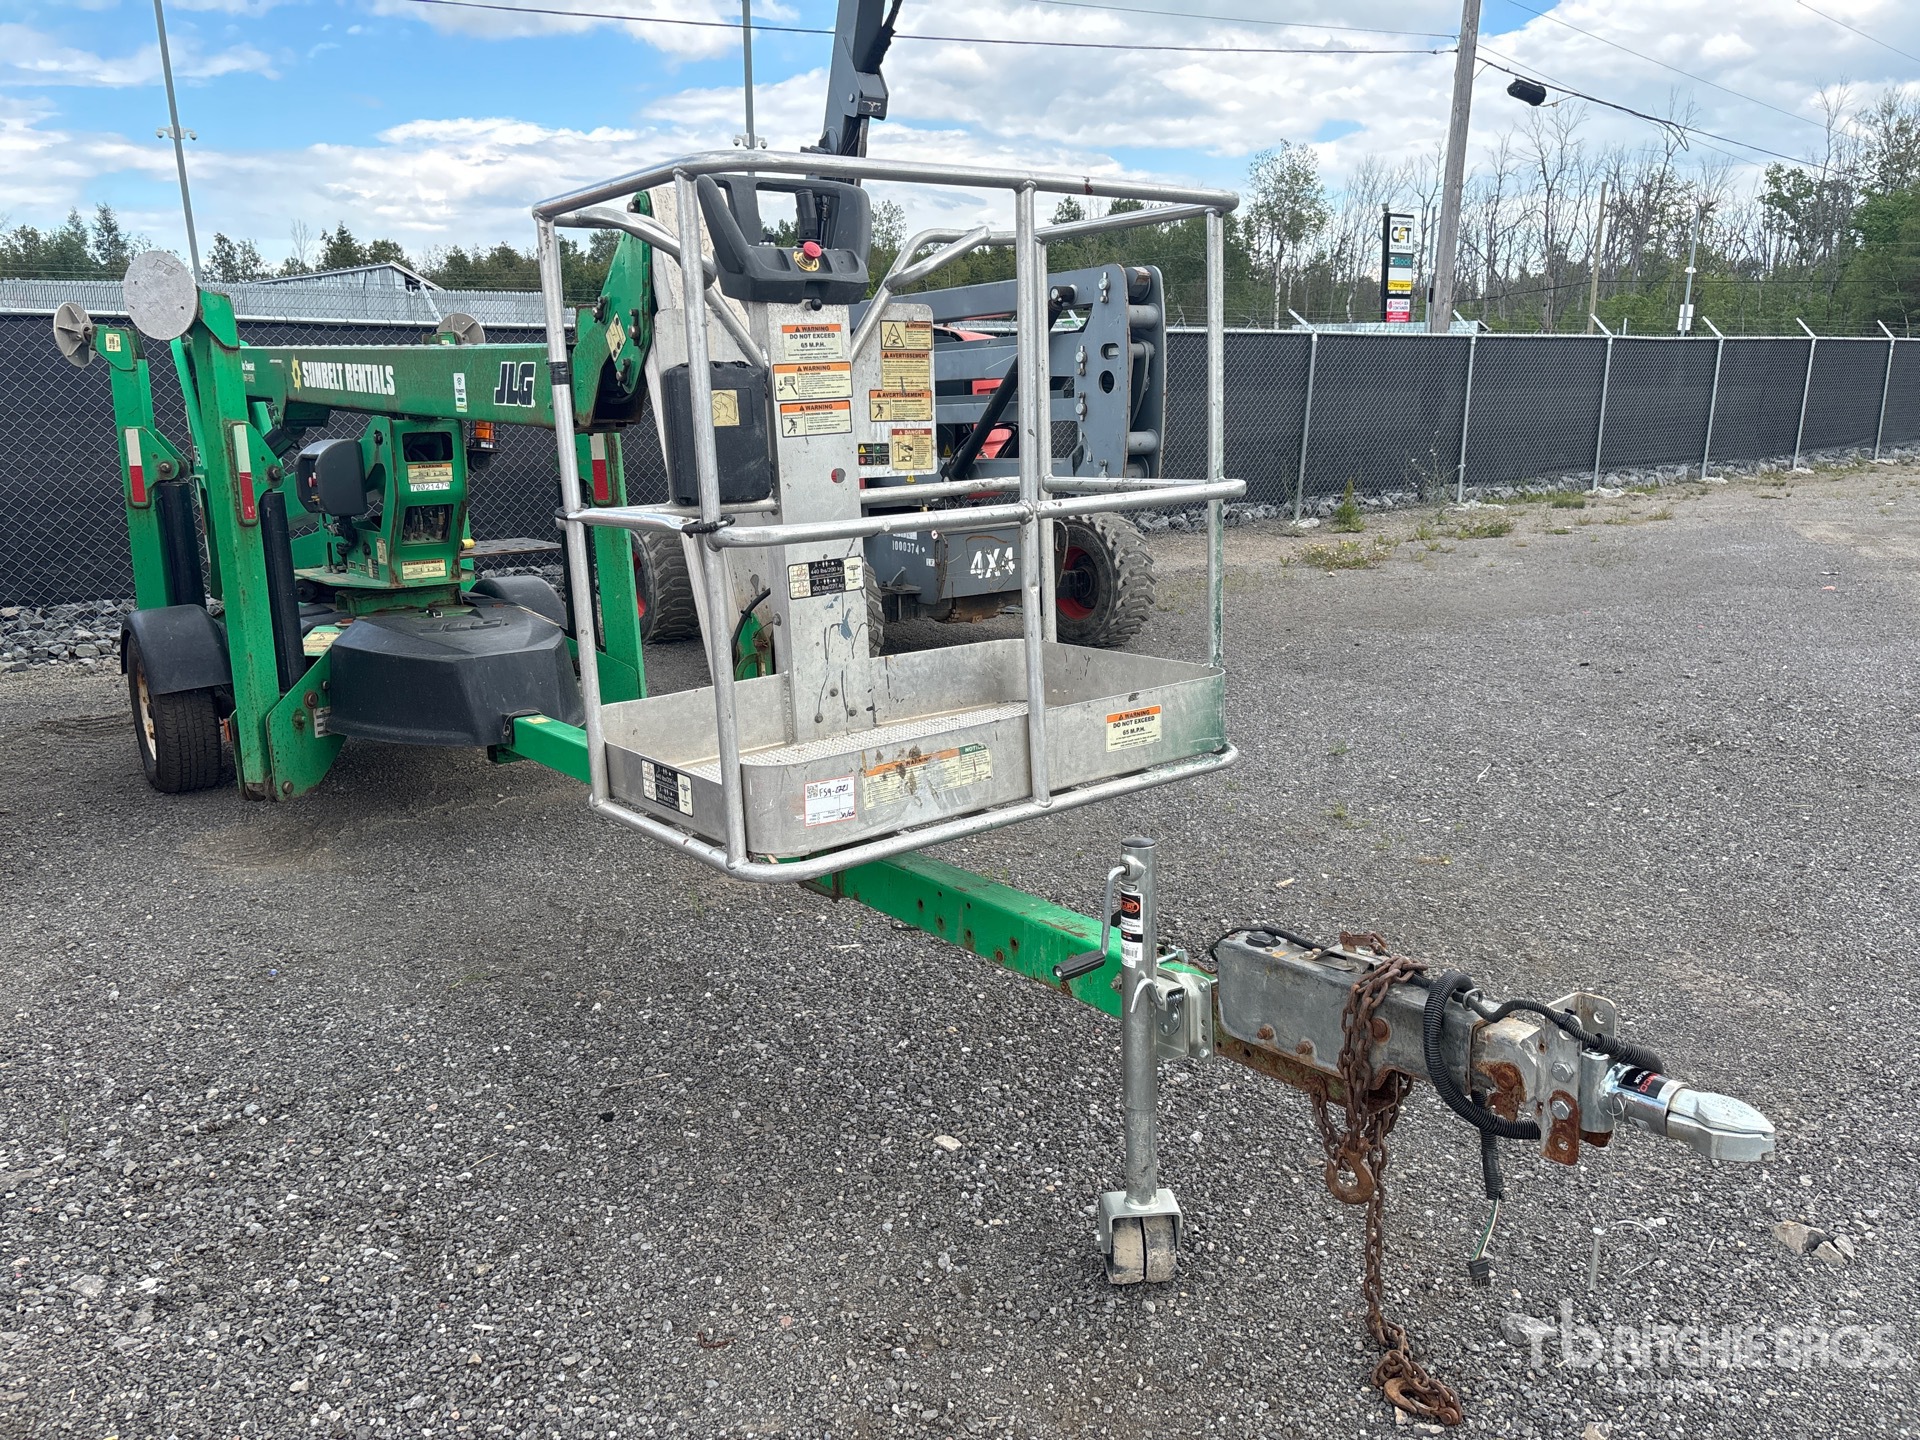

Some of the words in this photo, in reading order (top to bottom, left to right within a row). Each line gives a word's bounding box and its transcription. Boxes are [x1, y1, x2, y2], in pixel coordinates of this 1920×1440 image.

[803, 364, 831, 372] WARNING
[301, 361, 344, 391] SUNBELT
[345, 363, 395, 396] RENTALS
[493, 361, 536, 408] JLG
[892, 540, 920, 555] 1000374
[970, 546, 1016, 579] 4X4
[1124, 710, 1150, 719] WARNING
[1134, 716, 1155, 725] EXCEED
